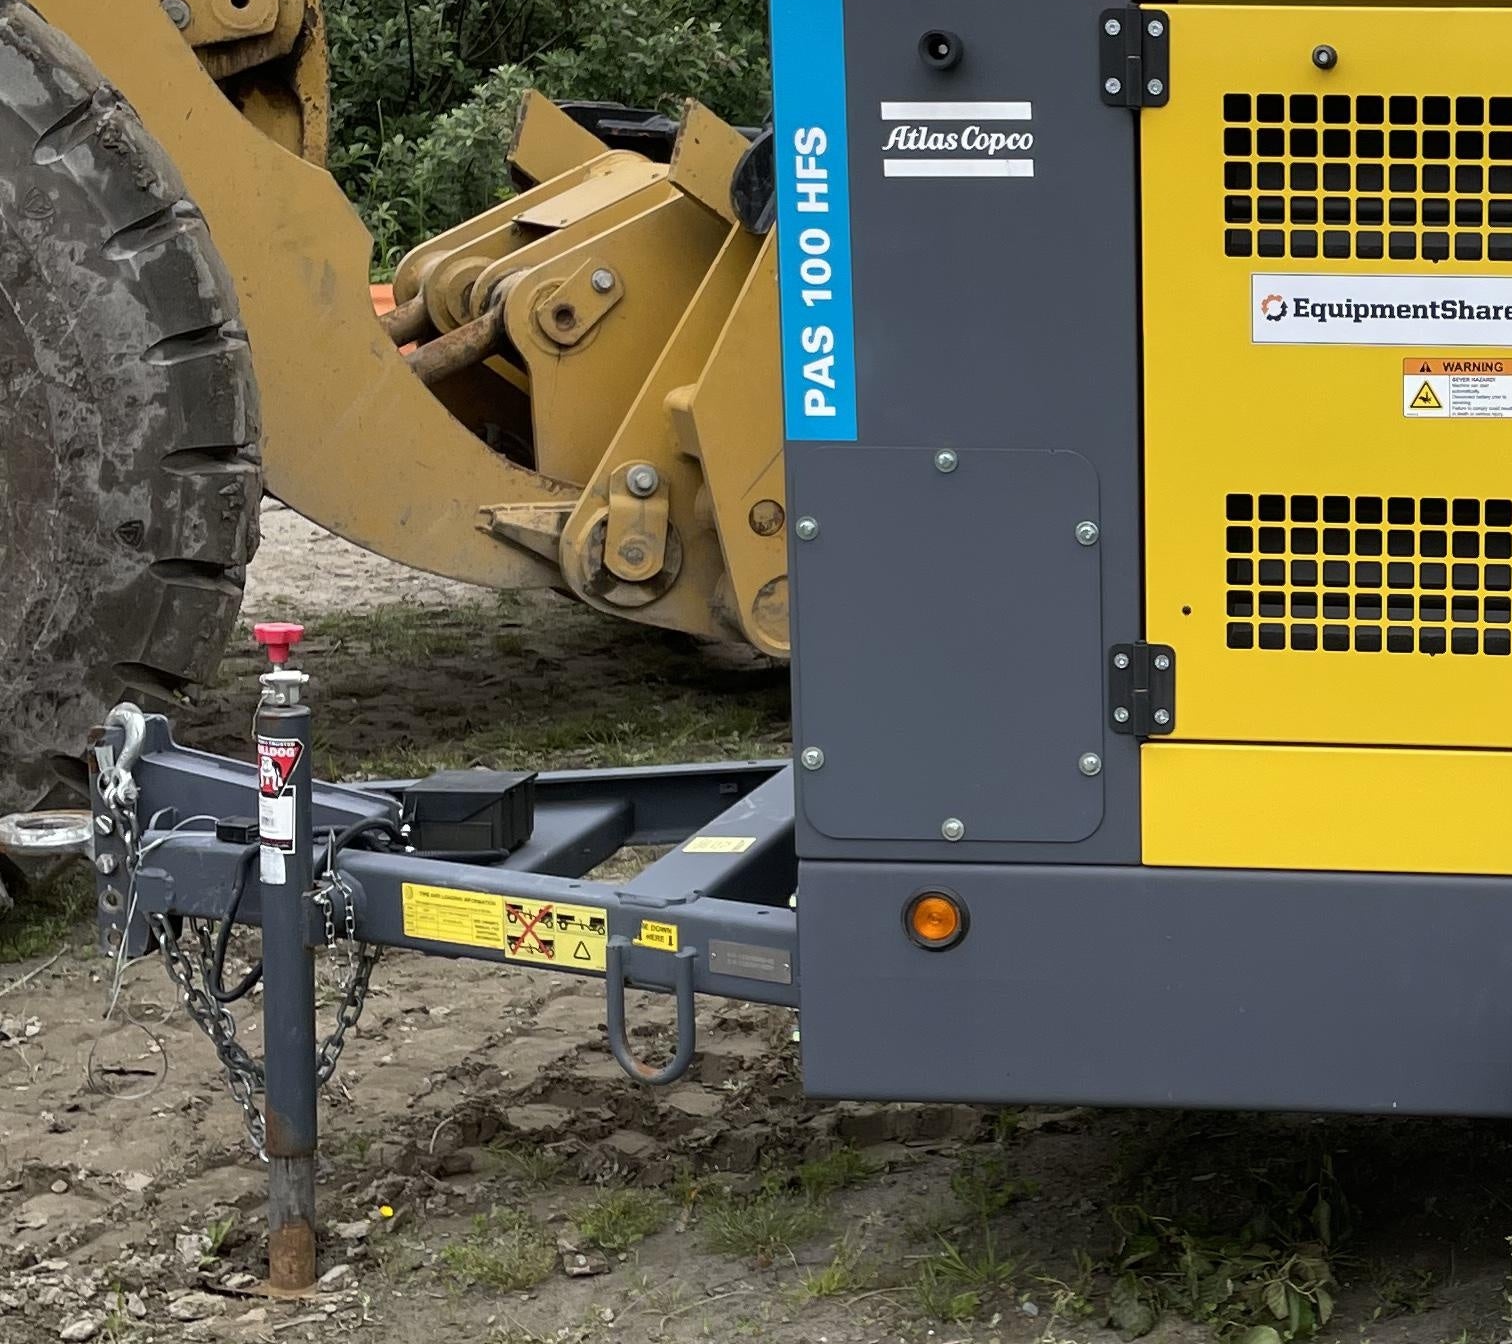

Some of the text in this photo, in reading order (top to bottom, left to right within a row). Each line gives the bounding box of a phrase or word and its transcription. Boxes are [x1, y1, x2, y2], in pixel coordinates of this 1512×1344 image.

[794, 126, 837, 417] PAS 100 HFS
[1442, 361, 1504, 373] WARNING
